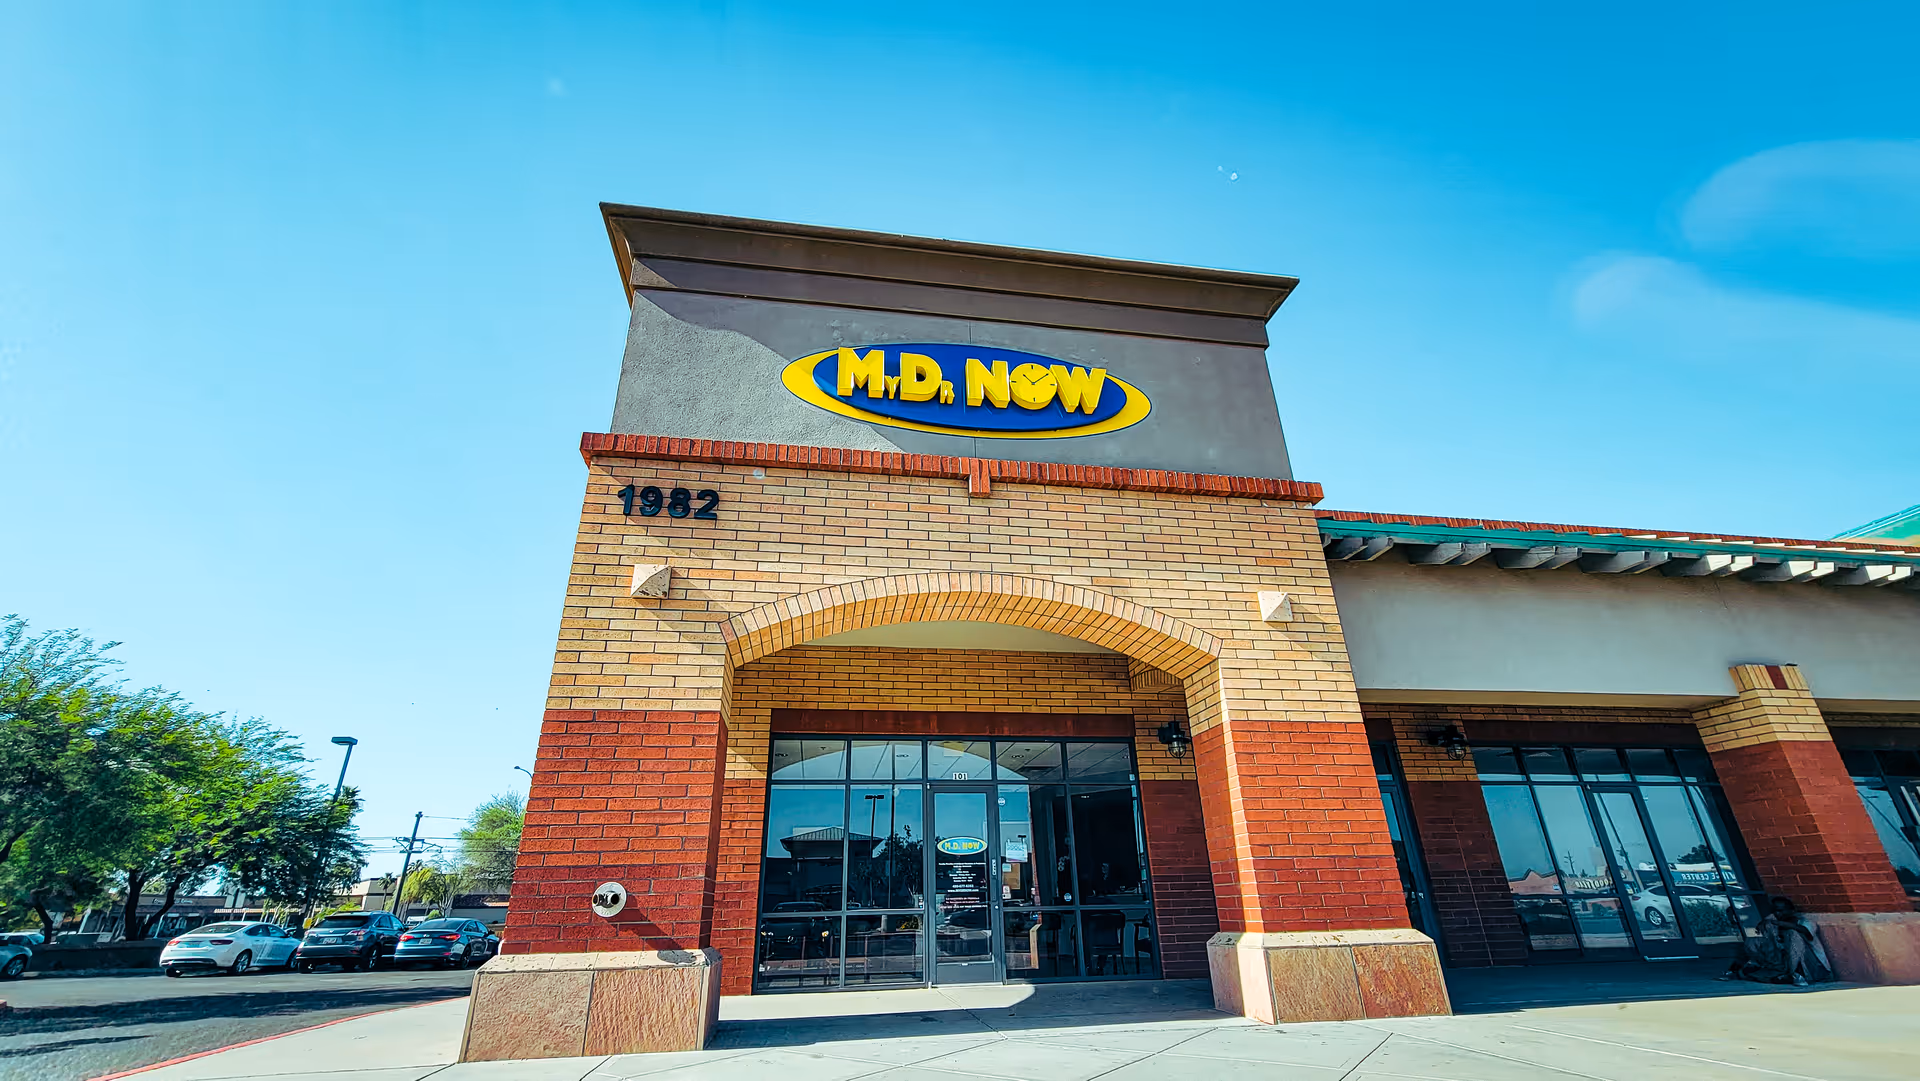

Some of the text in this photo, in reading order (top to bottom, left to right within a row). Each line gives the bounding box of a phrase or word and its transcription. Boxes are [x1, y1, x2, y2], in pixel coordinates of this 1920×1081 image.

[965, 358, 1107, 415] NOW
[617, 484, 720, 520] 1982
[962, 842, 980, 850] NOW
